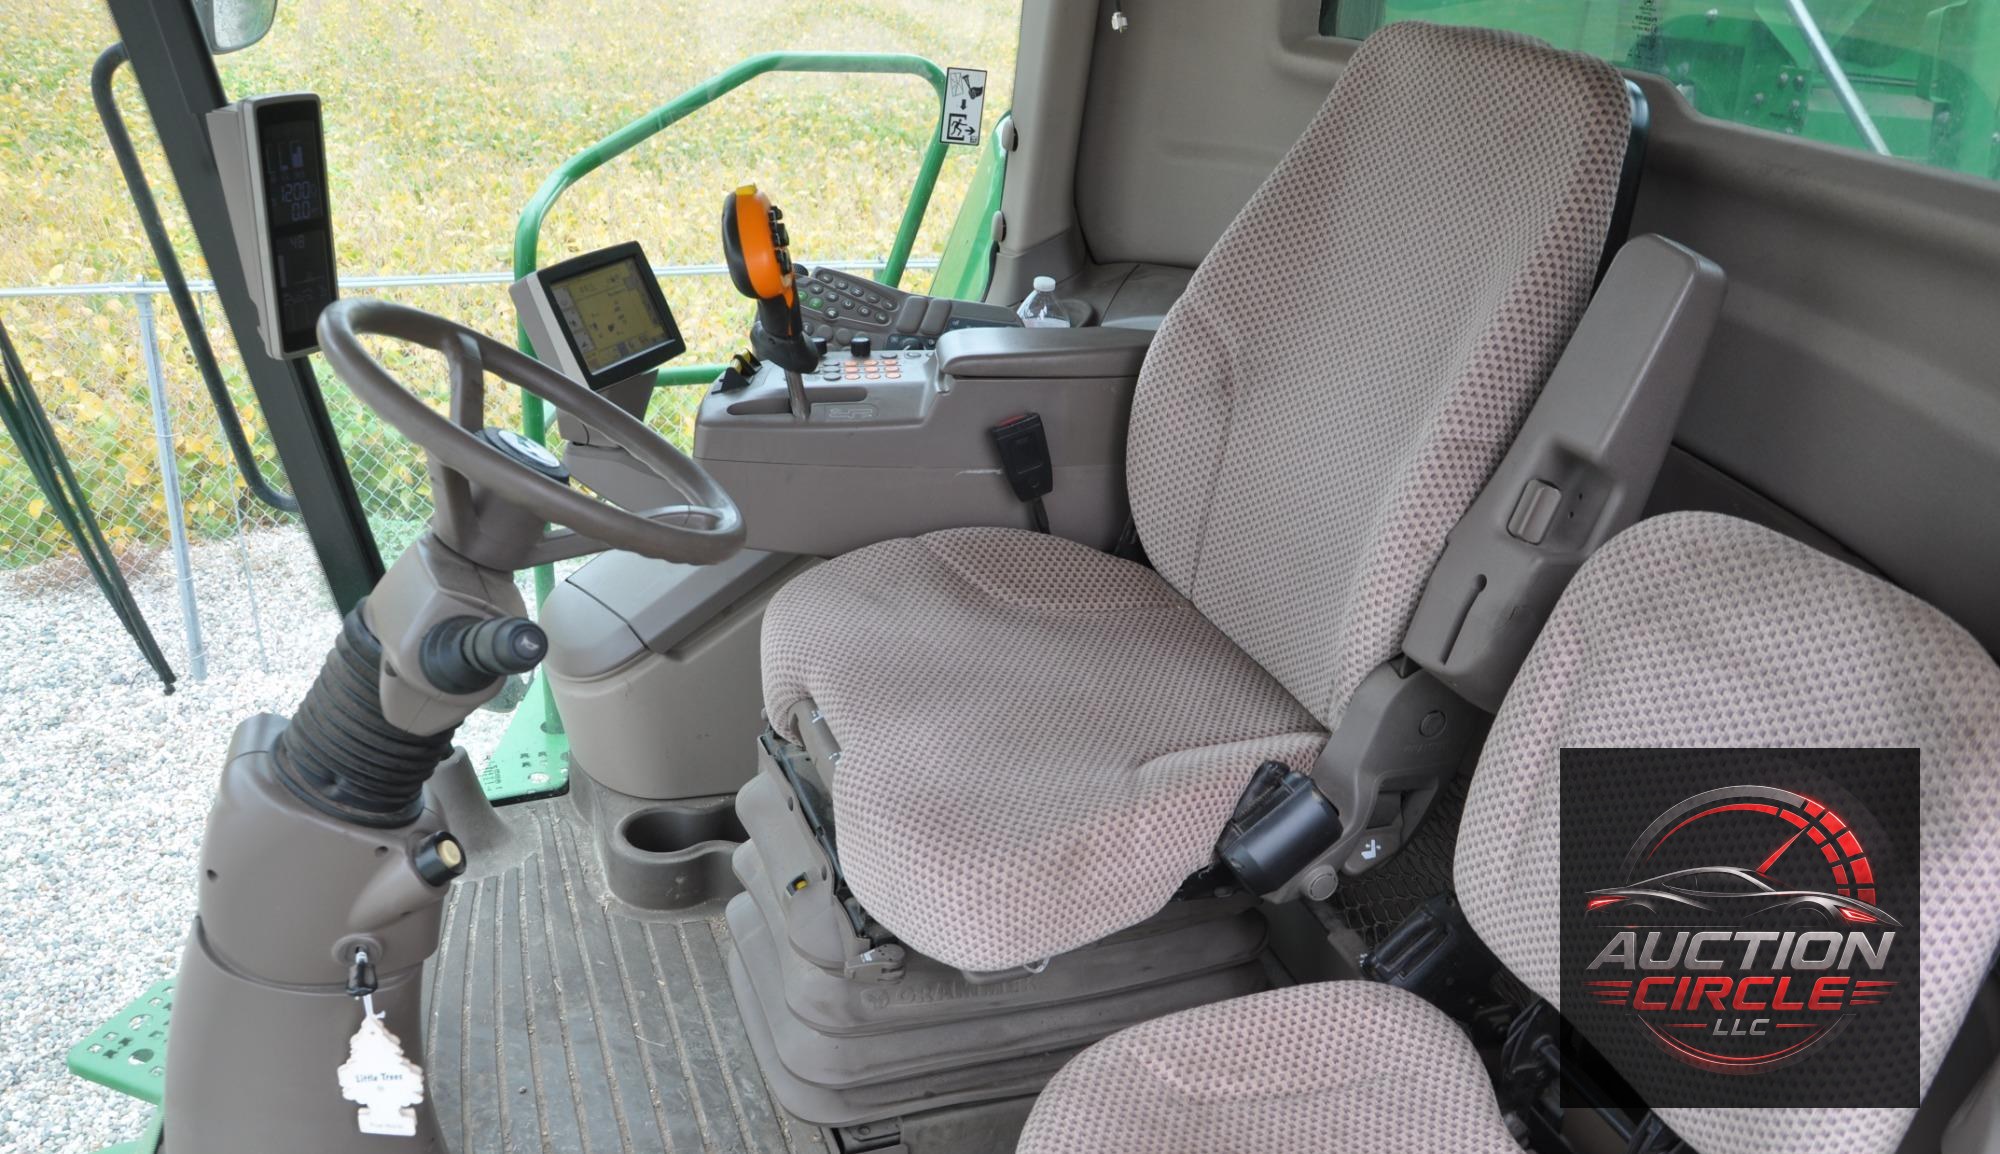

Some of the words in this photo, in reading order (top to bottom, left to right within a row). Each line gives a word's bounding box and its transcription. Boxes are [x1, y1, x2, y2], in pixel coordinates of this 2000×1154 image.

[280, 181, 311, 203] 1200
[355, 1073, 378, 1083] Little
[381, 1072, 403, 1081] Trees
